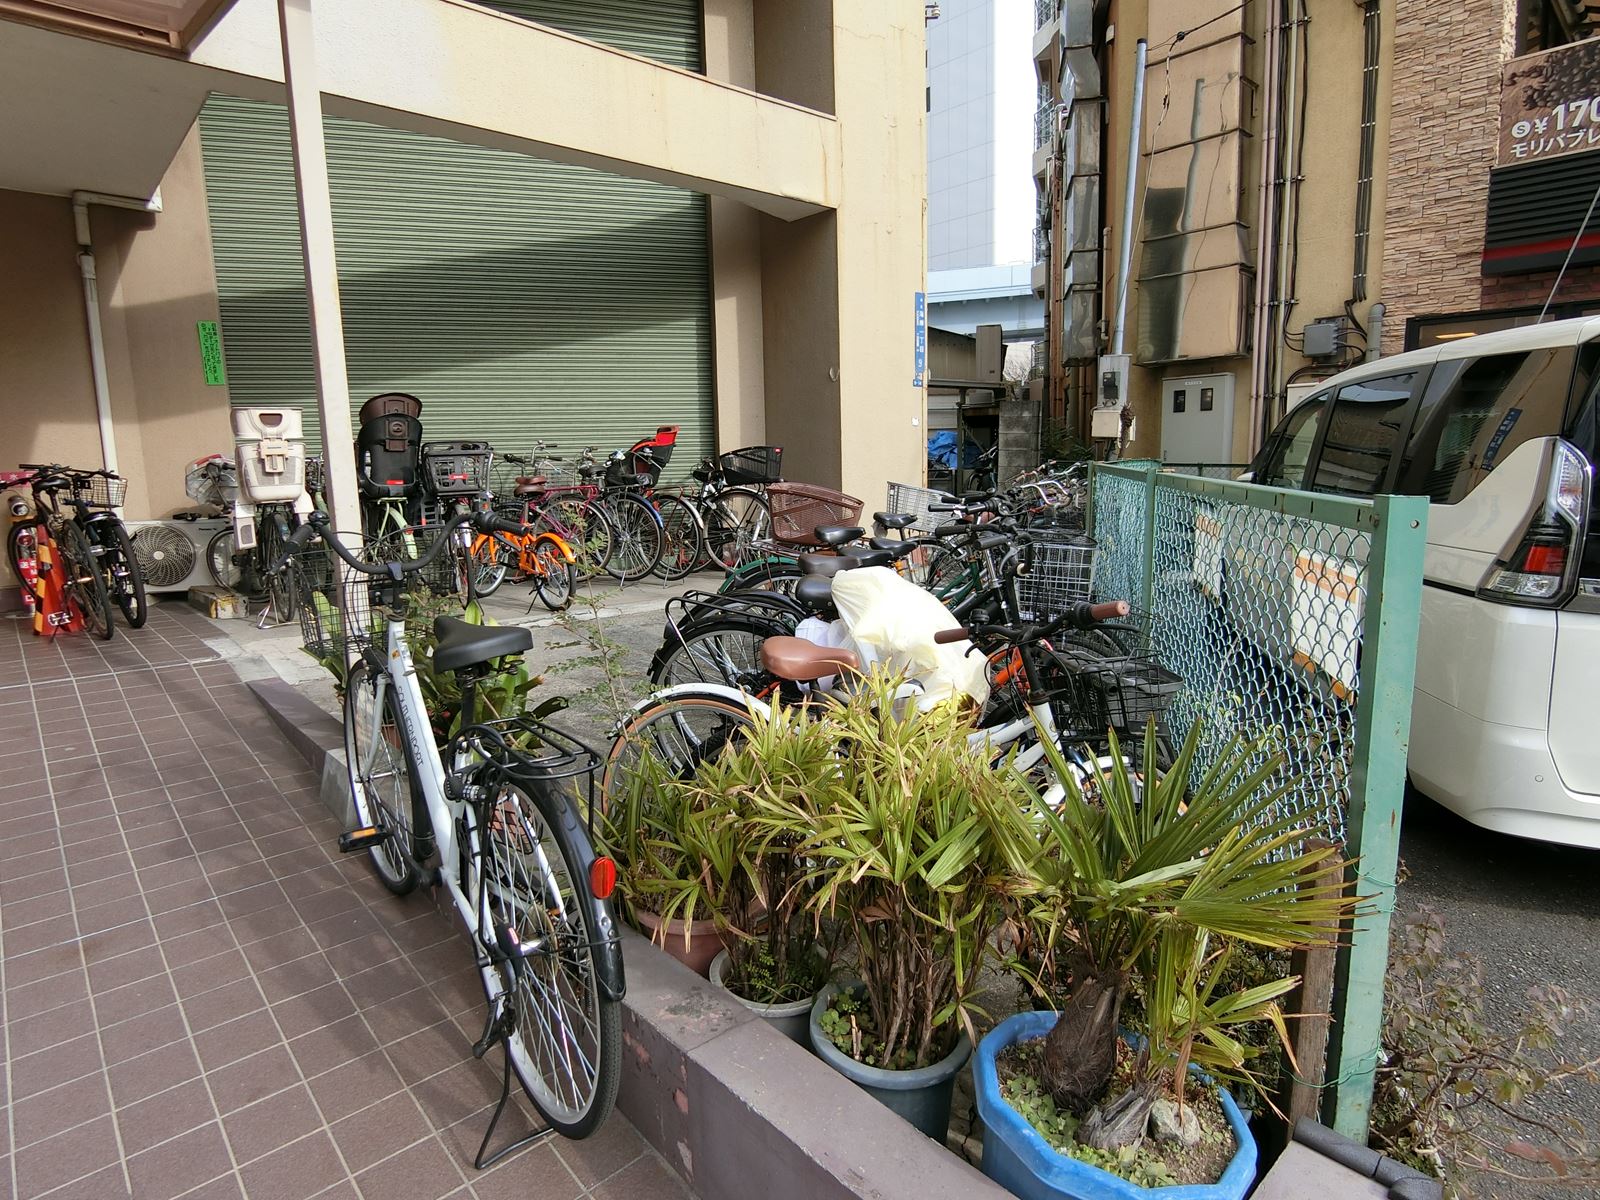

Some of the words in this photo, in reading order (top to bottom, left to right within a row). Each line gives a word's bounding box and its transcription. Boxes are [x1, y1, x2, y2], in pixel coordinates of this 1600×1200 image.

[1510, 128, 1600, 158] モリバブレ
